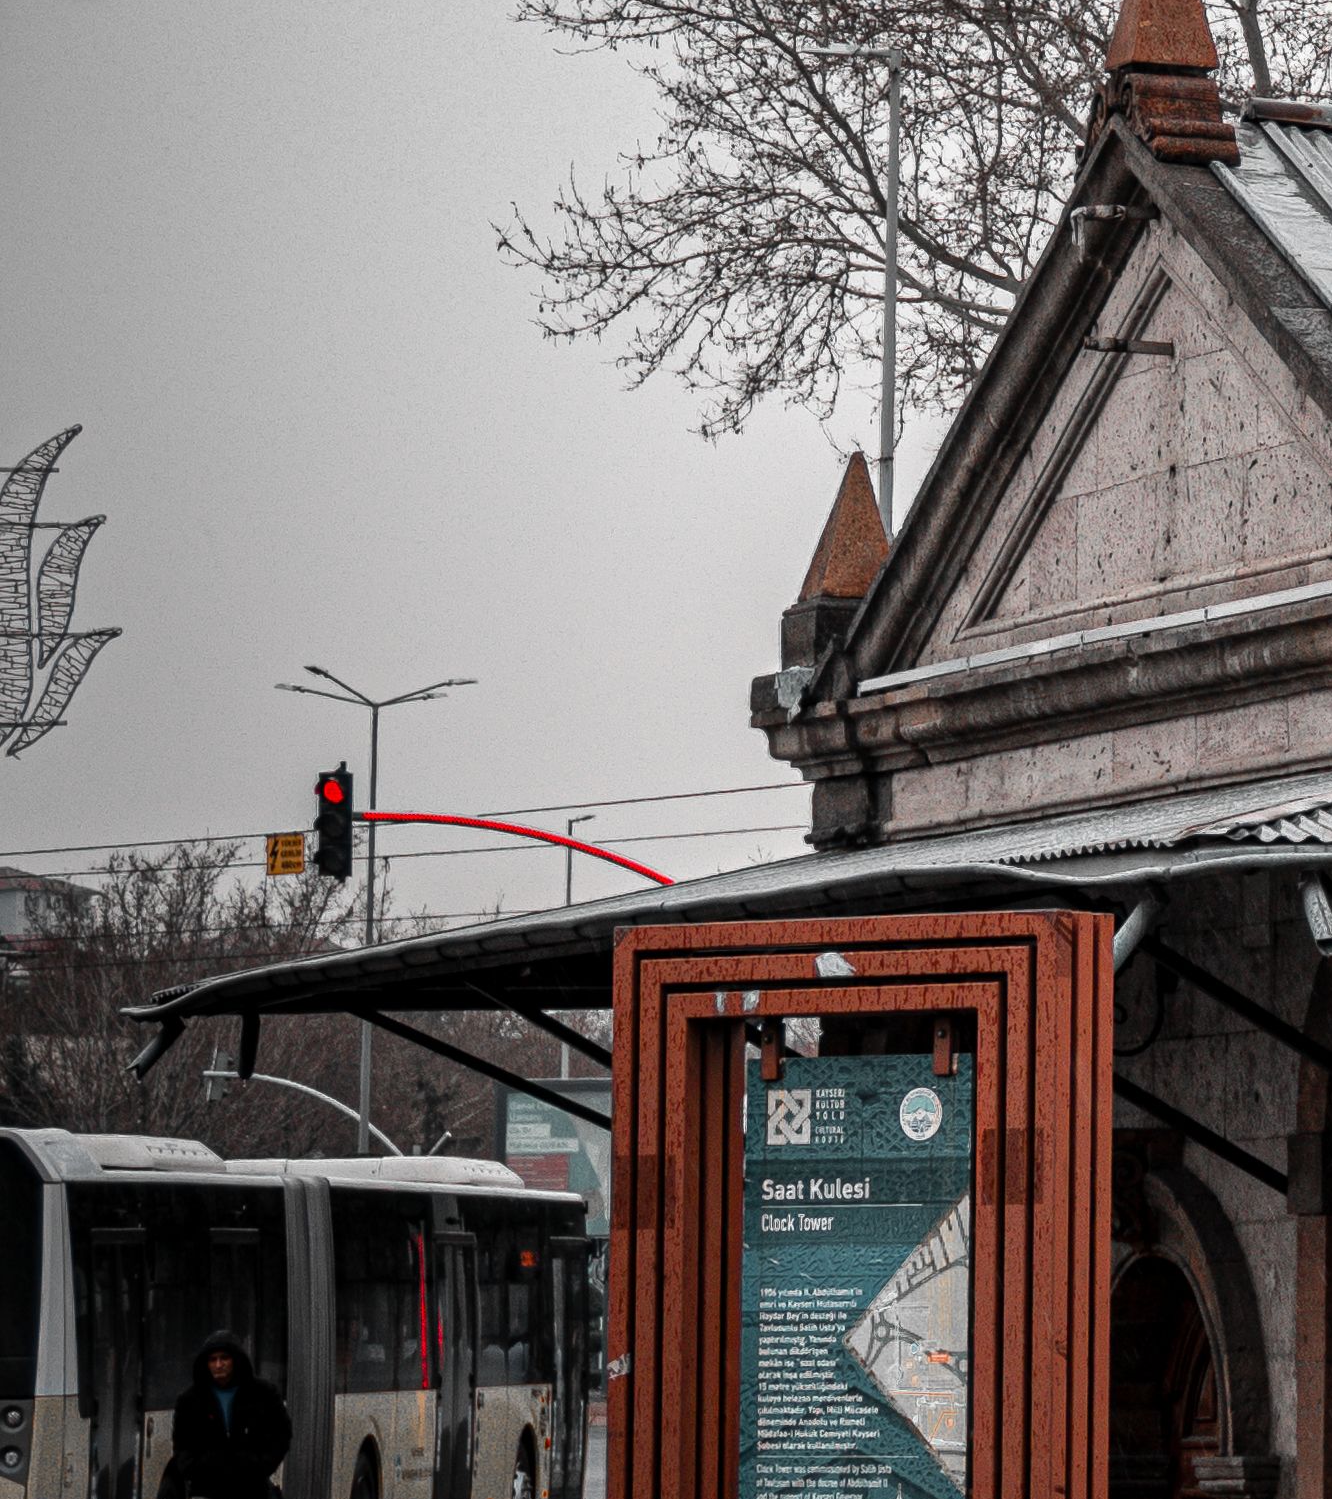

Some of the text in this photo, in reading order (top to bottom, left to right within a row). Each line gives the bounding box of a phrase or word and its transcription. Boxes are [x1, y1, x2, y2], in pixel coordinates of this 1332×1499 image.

[762, 1177, 870, 1200] Saat Kulesi
[761, 1213, 834, 1232] Clock Tower
